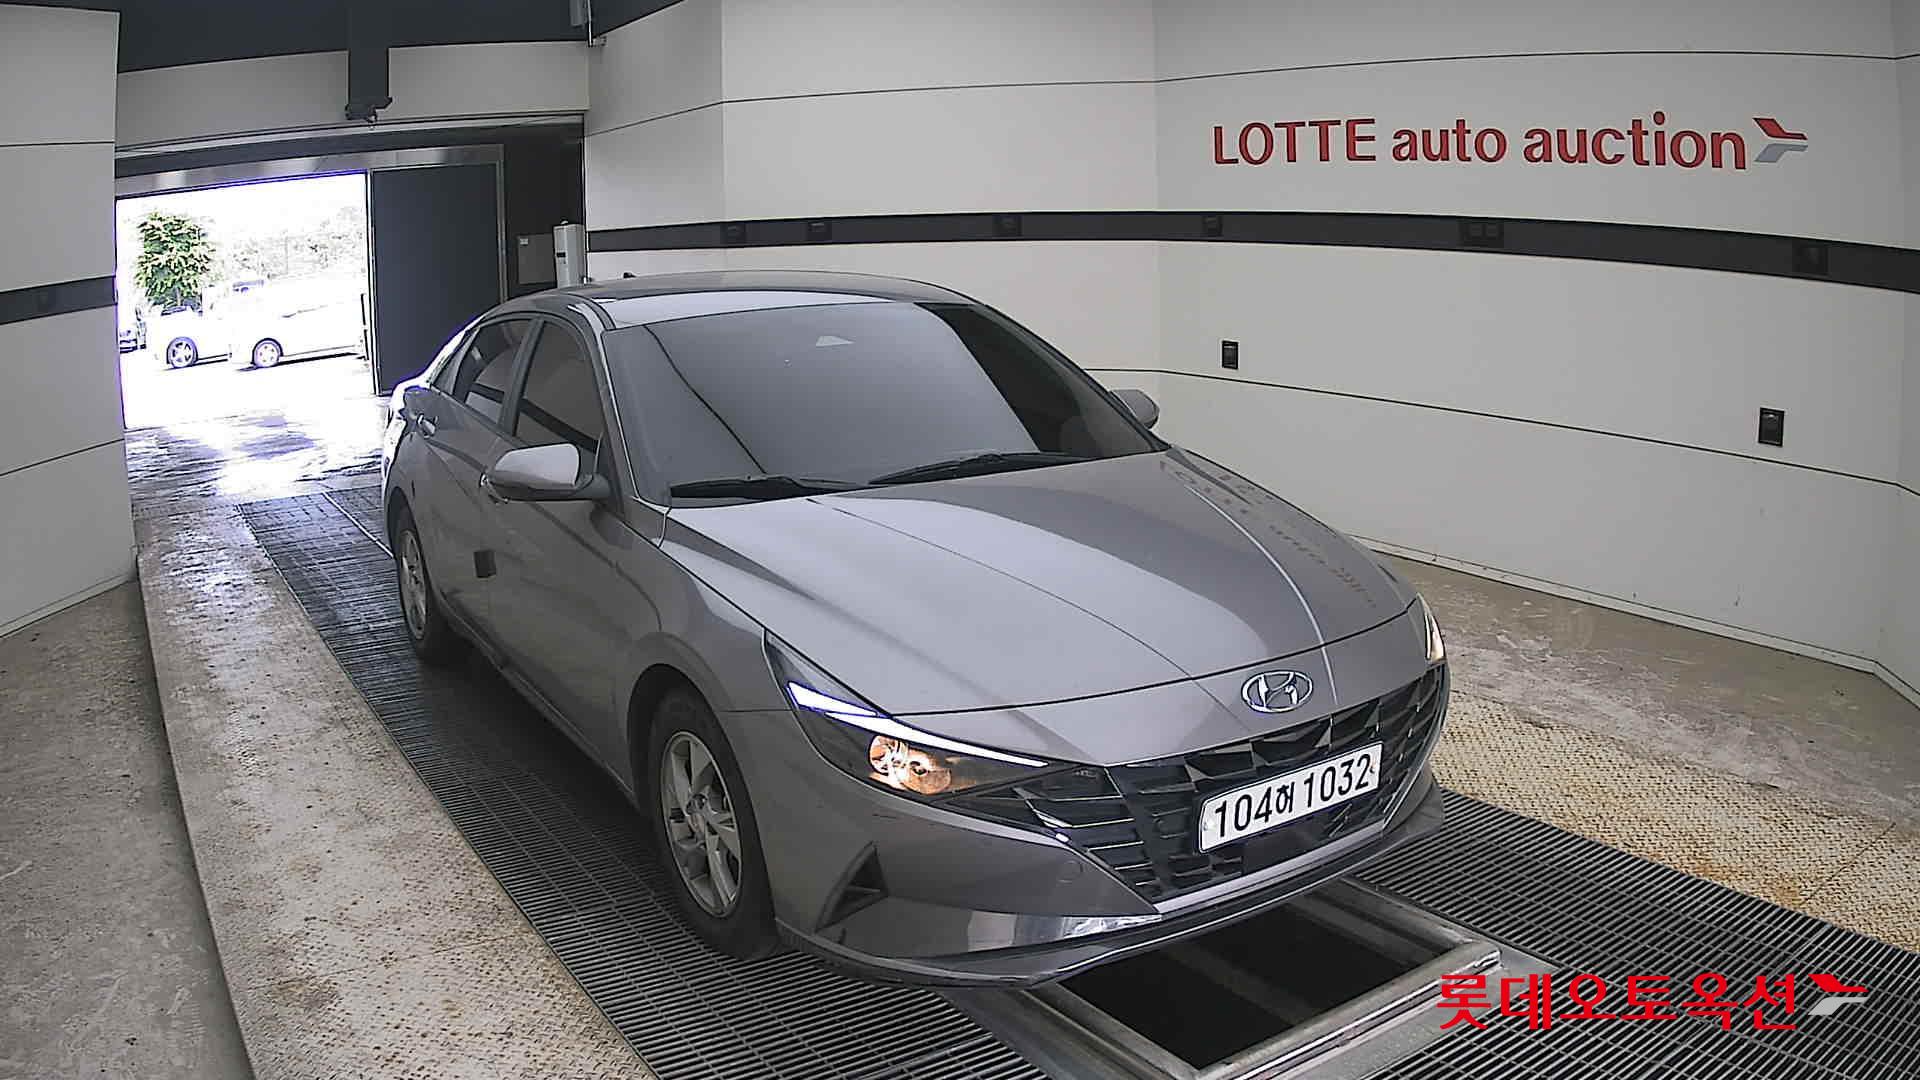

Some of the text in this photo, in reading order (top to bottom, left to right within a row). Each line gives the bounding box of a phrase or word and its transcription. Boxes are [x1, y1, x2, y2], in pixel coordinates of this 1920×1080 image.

[1213, 111, 1747, 171] LOTTE auto auction
[1303, 753, 1371, 808] 1032
